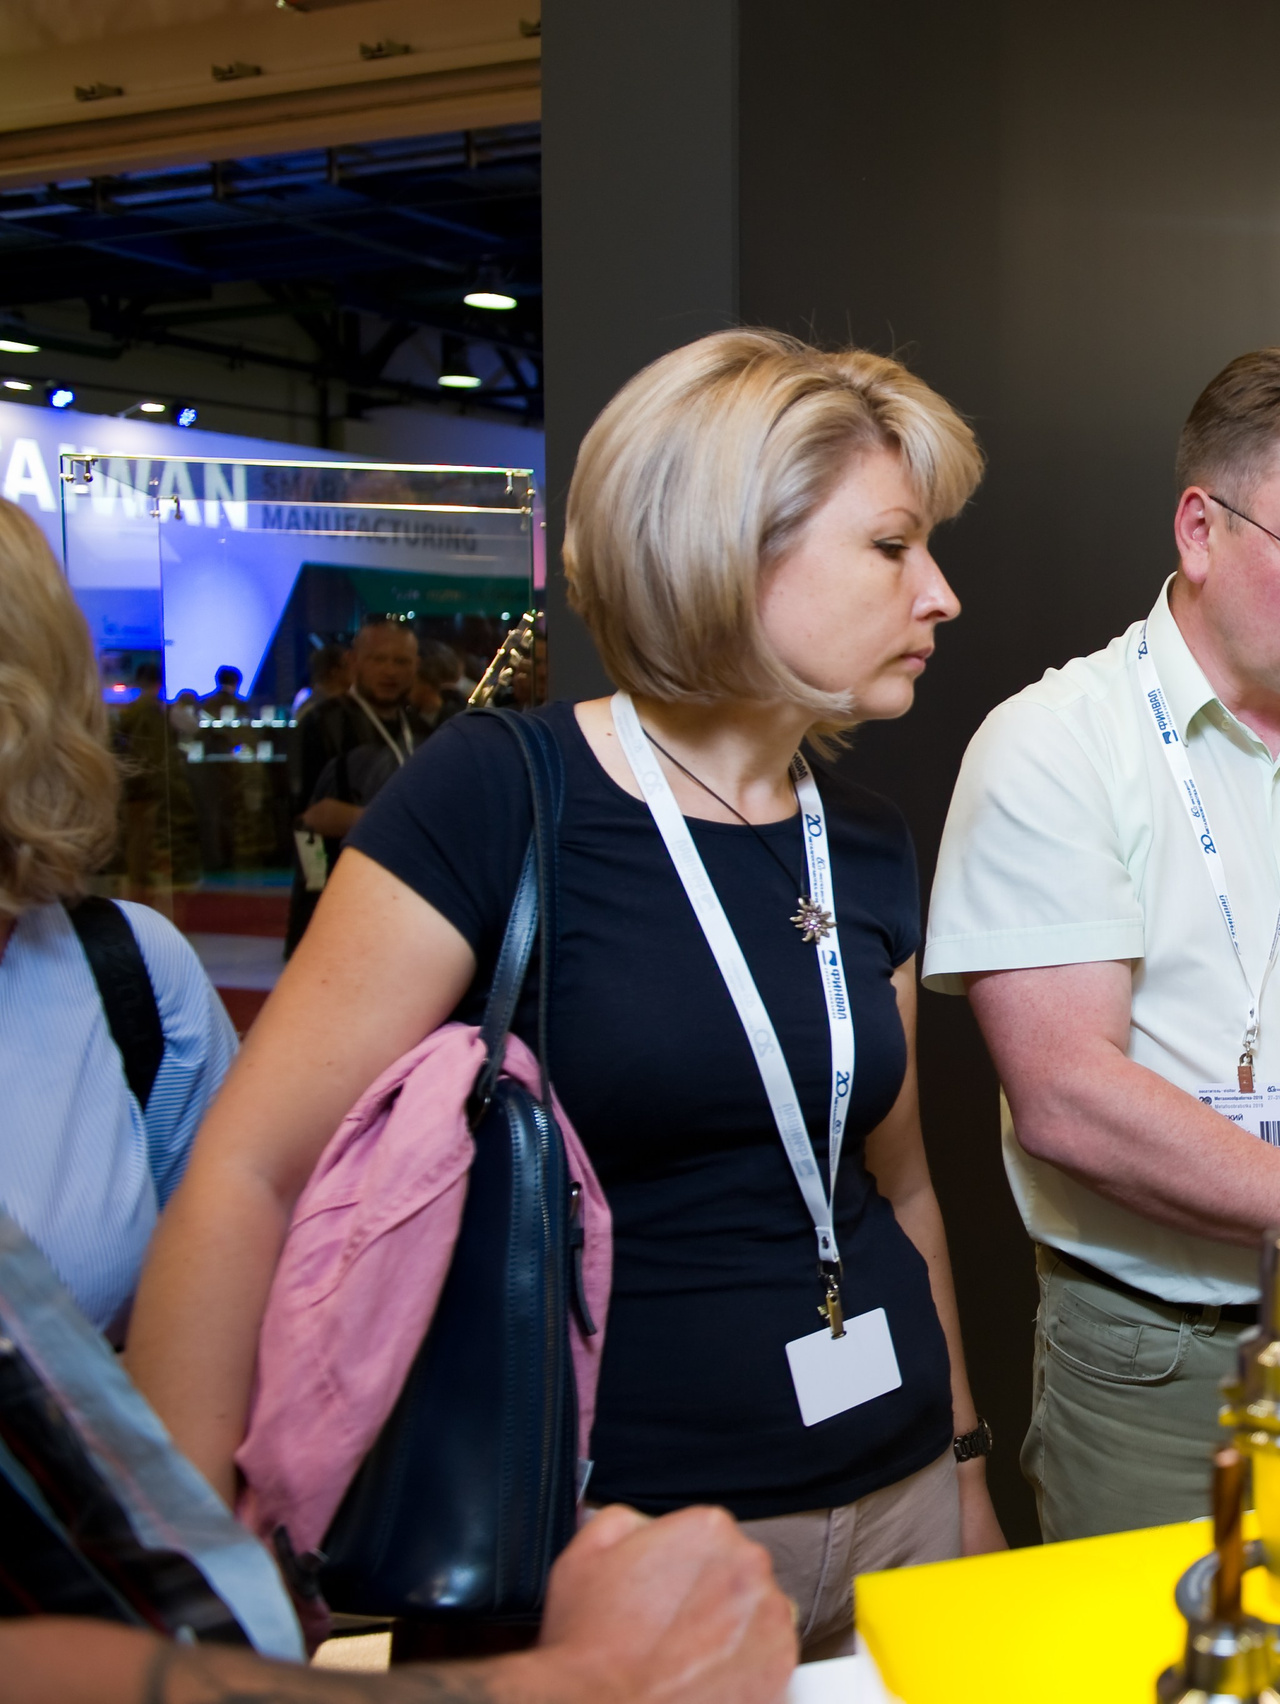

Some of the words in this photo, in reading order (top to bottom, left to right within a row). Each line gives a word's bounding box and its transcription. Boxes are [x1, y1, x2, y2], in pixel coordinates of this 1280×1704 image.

[0, 438, 248, 530] AIWAN
[262, 504, 478, 553] MANUFACTURING
[1147, 689, 1168, 731] ФИНВАЛ
[805, 813, 822, 838] 20
[1200, 834, 1216, 854] 20
[831, 968, 847, 1020] ФИНВАЛ
[836, 1070, 850, 1098] 20
